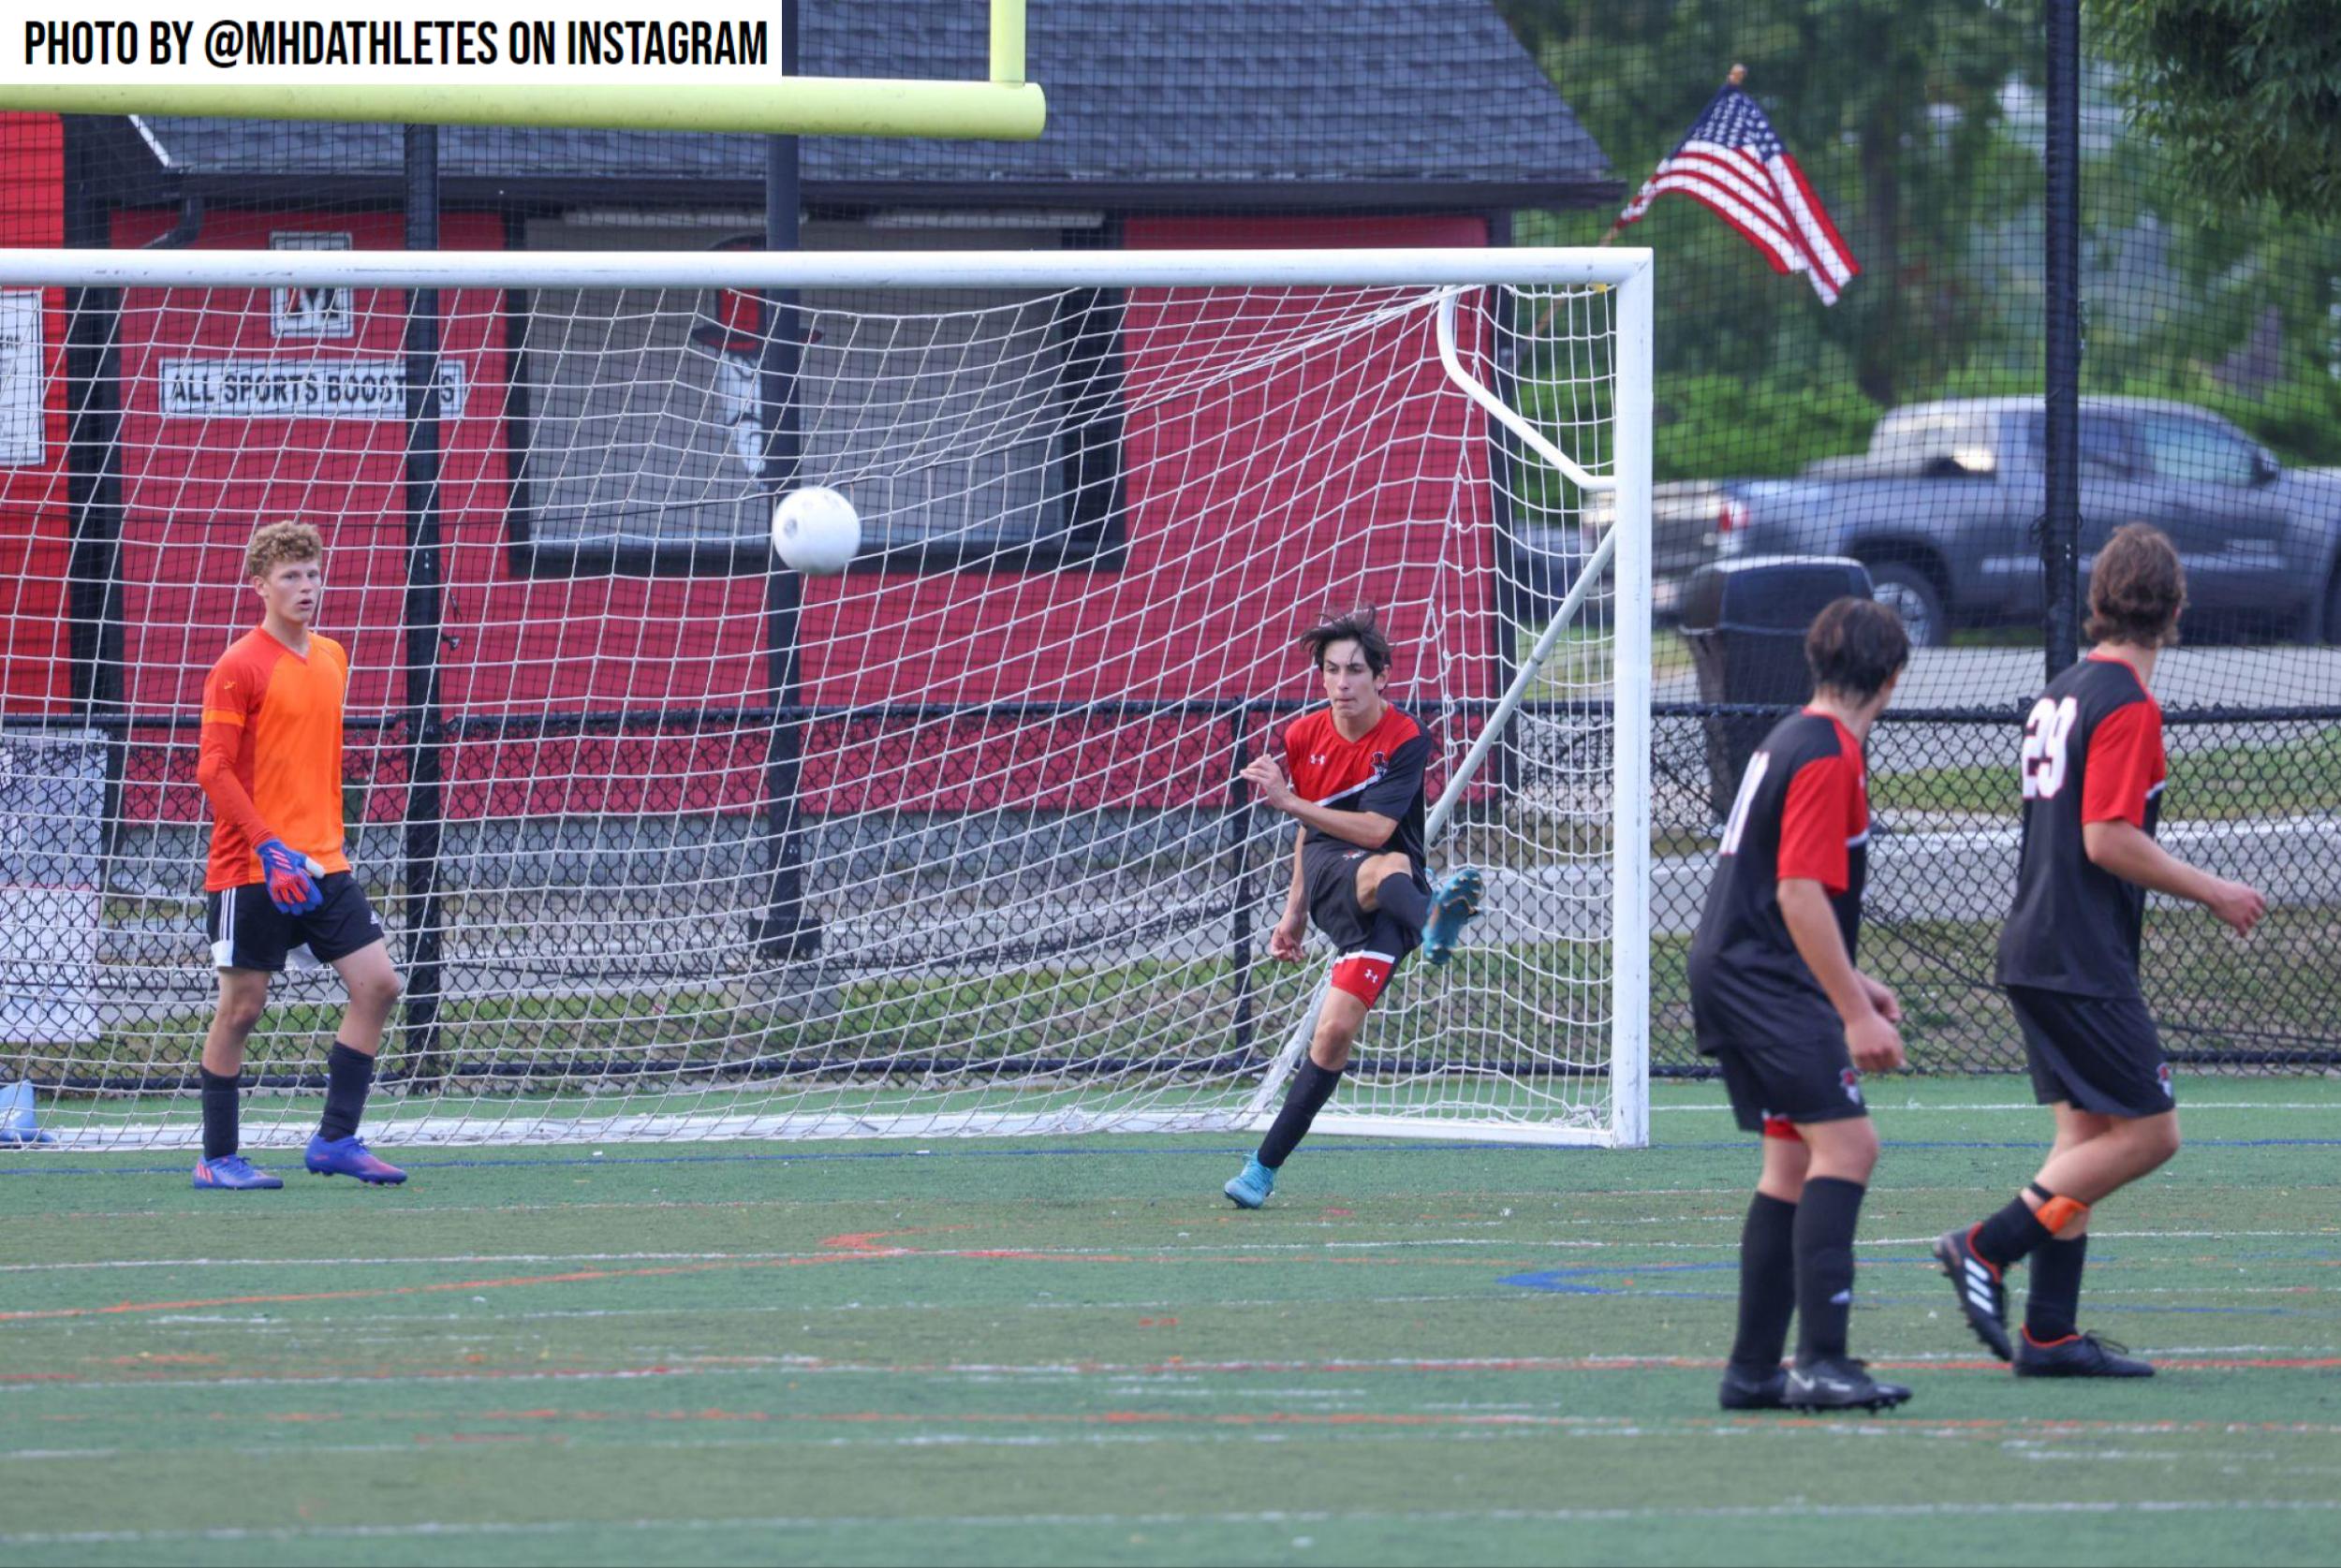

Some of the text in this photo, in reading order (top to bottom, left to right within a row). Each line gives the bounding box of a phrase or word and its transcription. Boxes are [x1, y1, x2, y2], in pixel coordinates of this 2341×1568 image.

[171, 374, 455, 404] ALL SPORTS BOOSTS
[2021, 696, 2078, 799] 29
